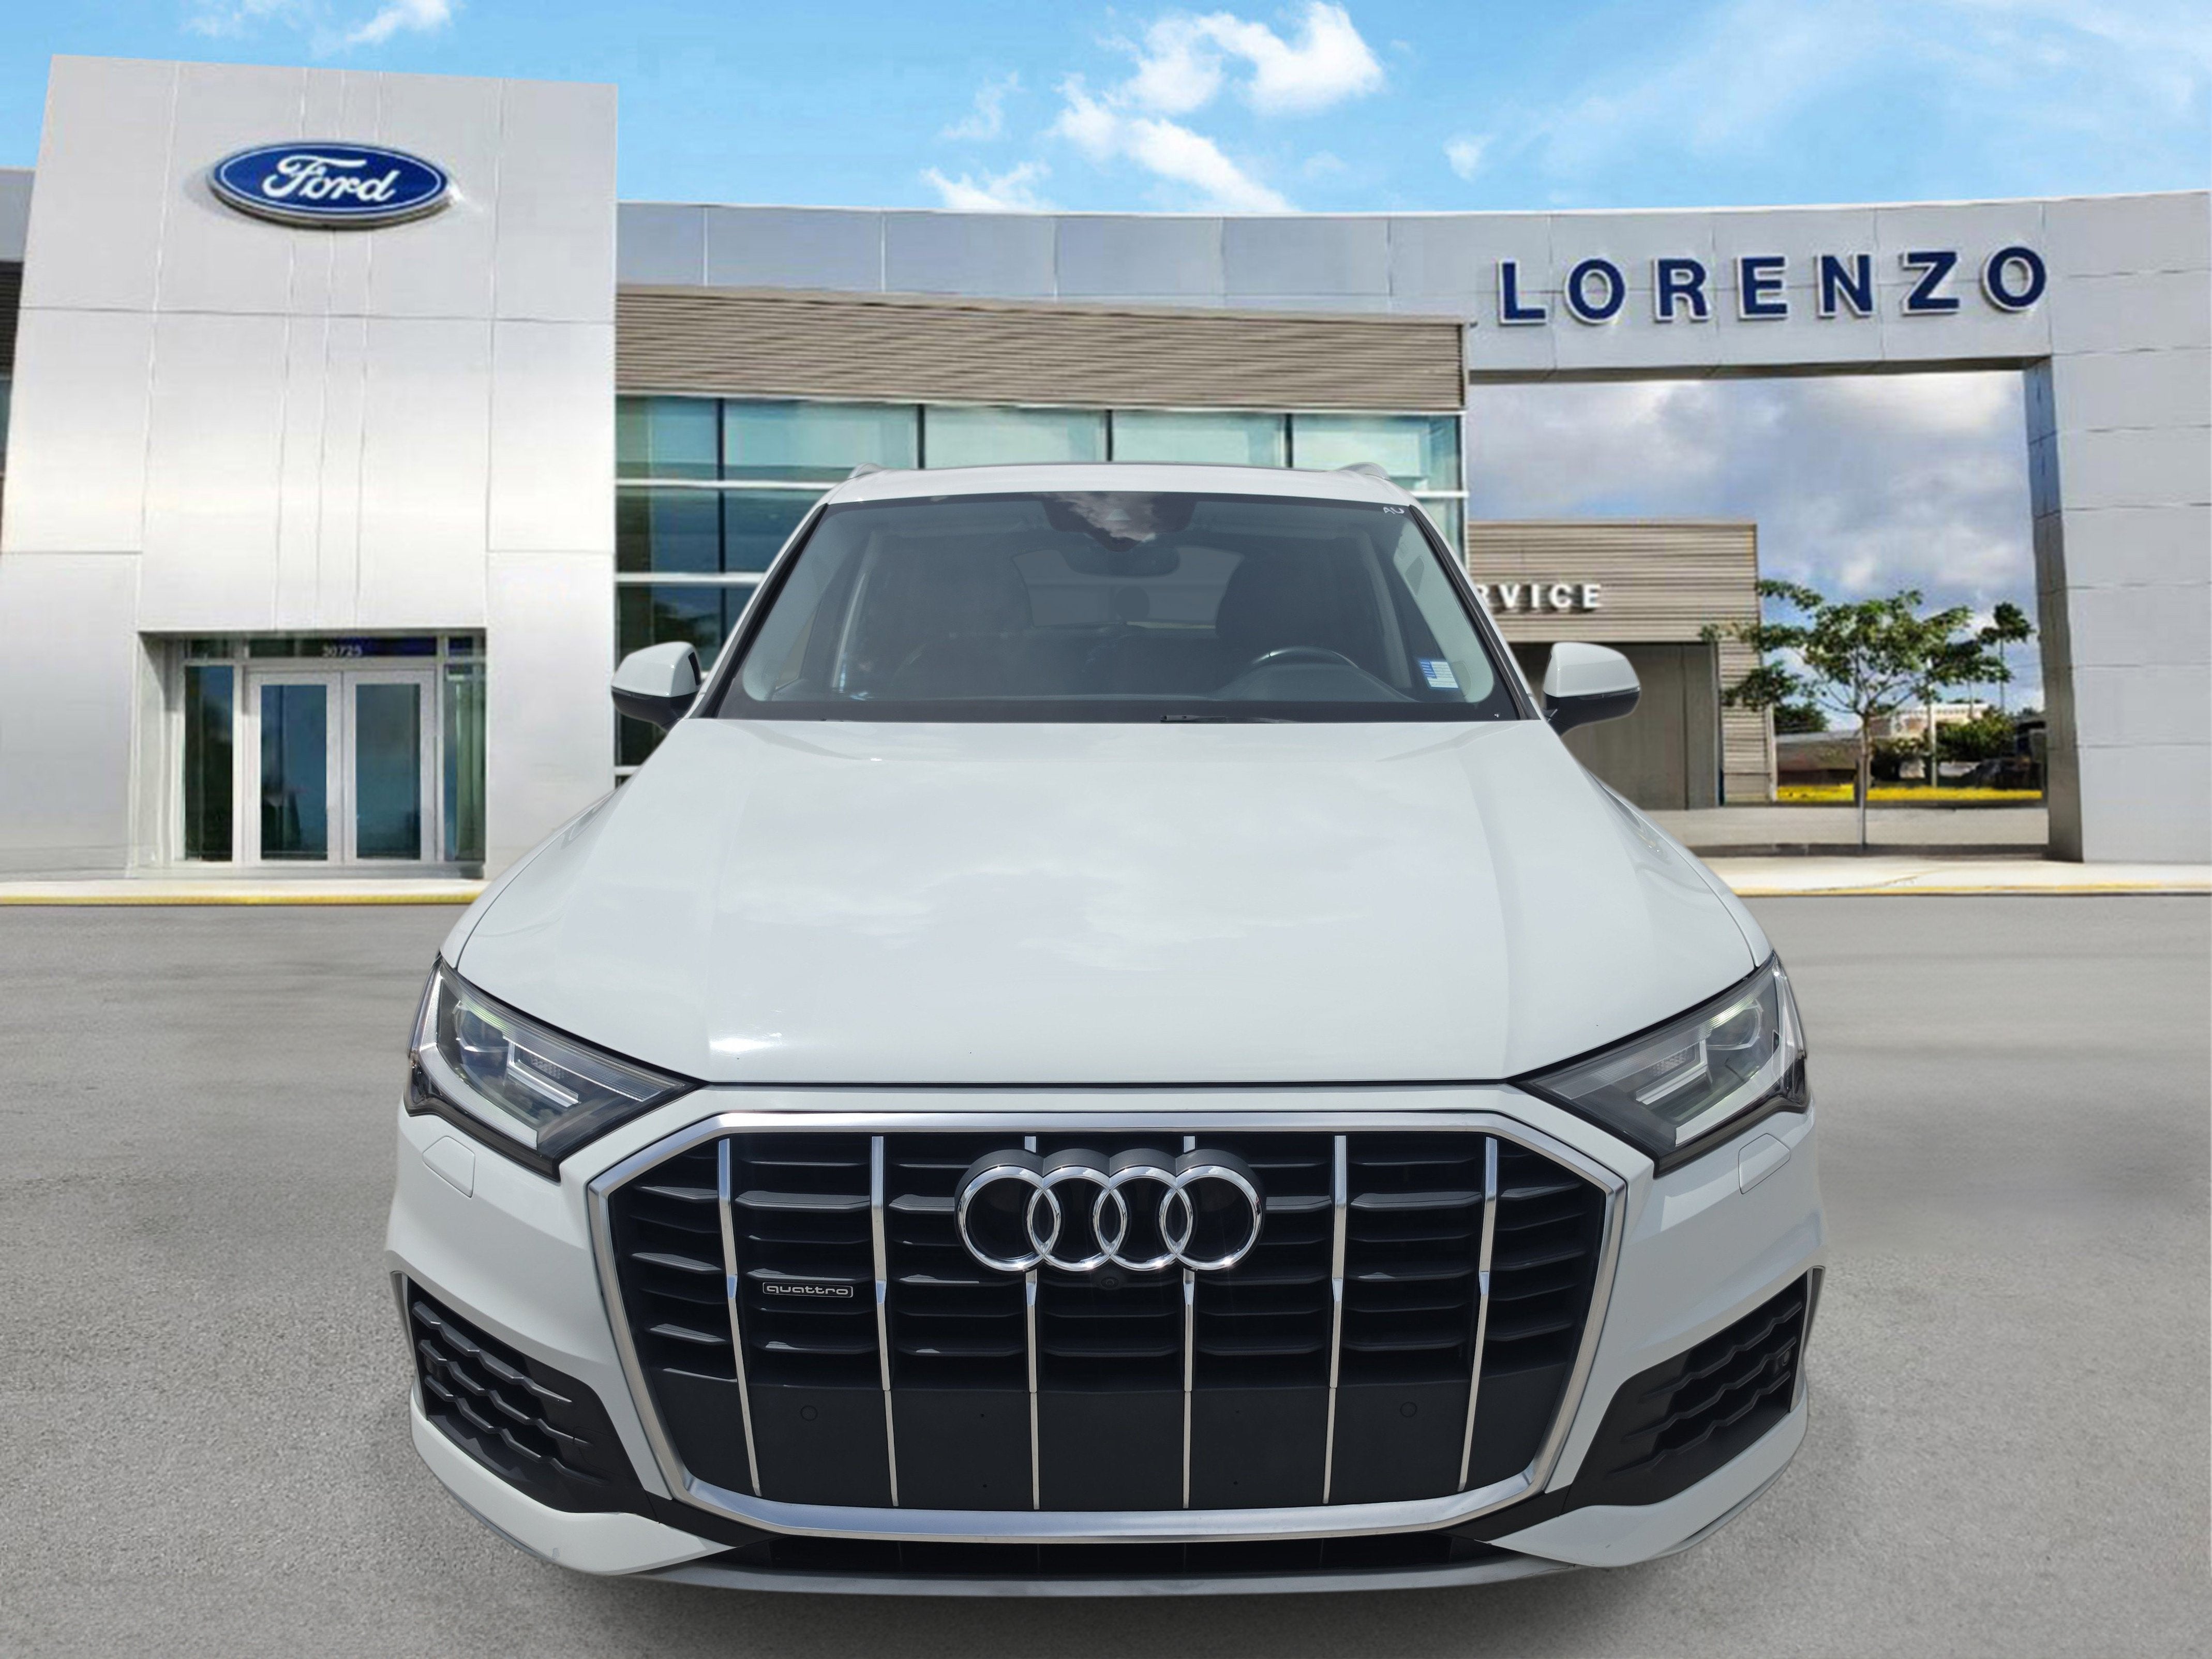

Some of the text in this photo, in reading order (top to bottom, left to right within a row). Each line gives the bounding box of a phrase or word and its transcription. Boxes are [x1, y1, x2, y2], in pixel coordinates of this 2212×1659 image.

[262, 155, 400, 201] Ford
[1497, 246, 2047, 324] LORENZO
[766, 1286, 848, 1295] quattro
